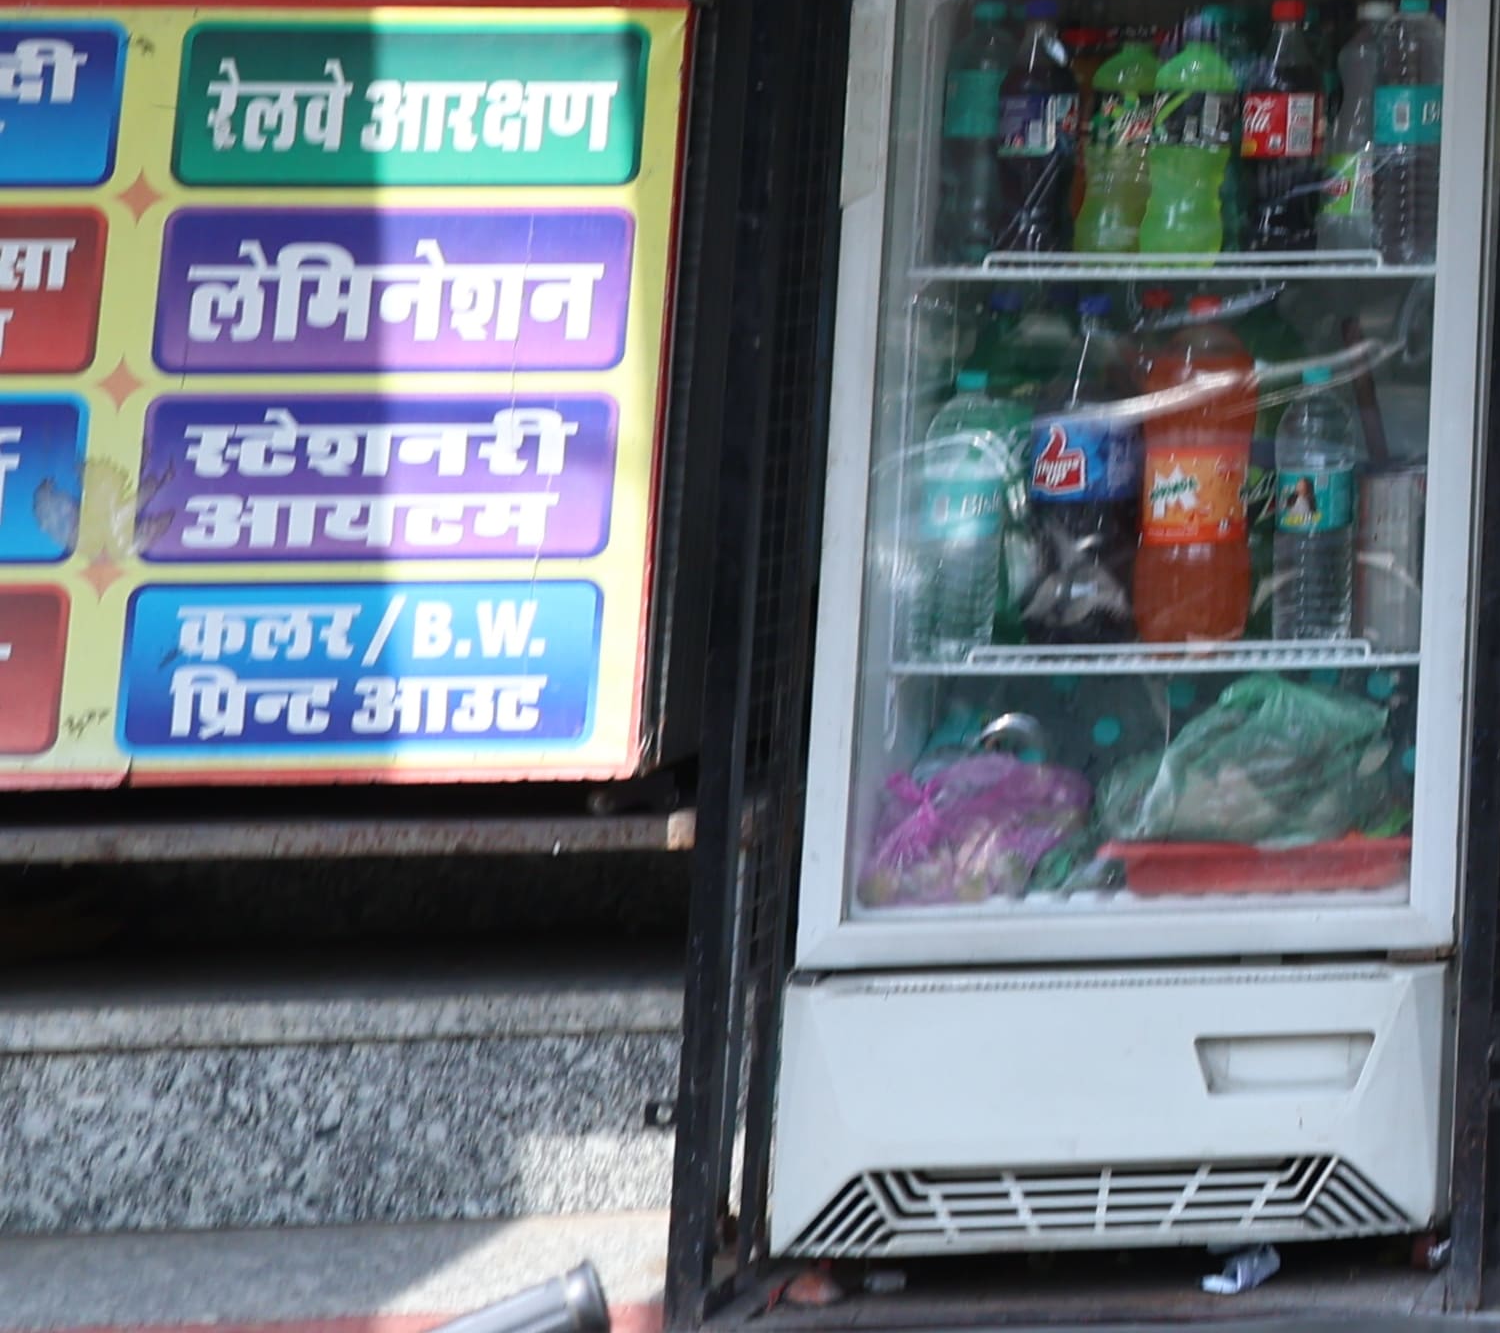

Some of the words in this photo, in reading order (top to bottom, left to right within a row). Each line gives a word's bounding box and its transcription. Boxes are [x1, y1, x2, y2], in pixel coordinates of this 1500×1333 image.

[206, 58, 353, 152] रेलवे
[360, 78, 619, 155] आरक्षण
[186, 239, 606, 345] लेमिनेशन
[182, 405, 580, 478] स्टेशनरी
[182, 491, 560, 550] आयटम
[168, 667, 339, 742] प्रिन्ट
[353, 675, 551, 736] आउट
